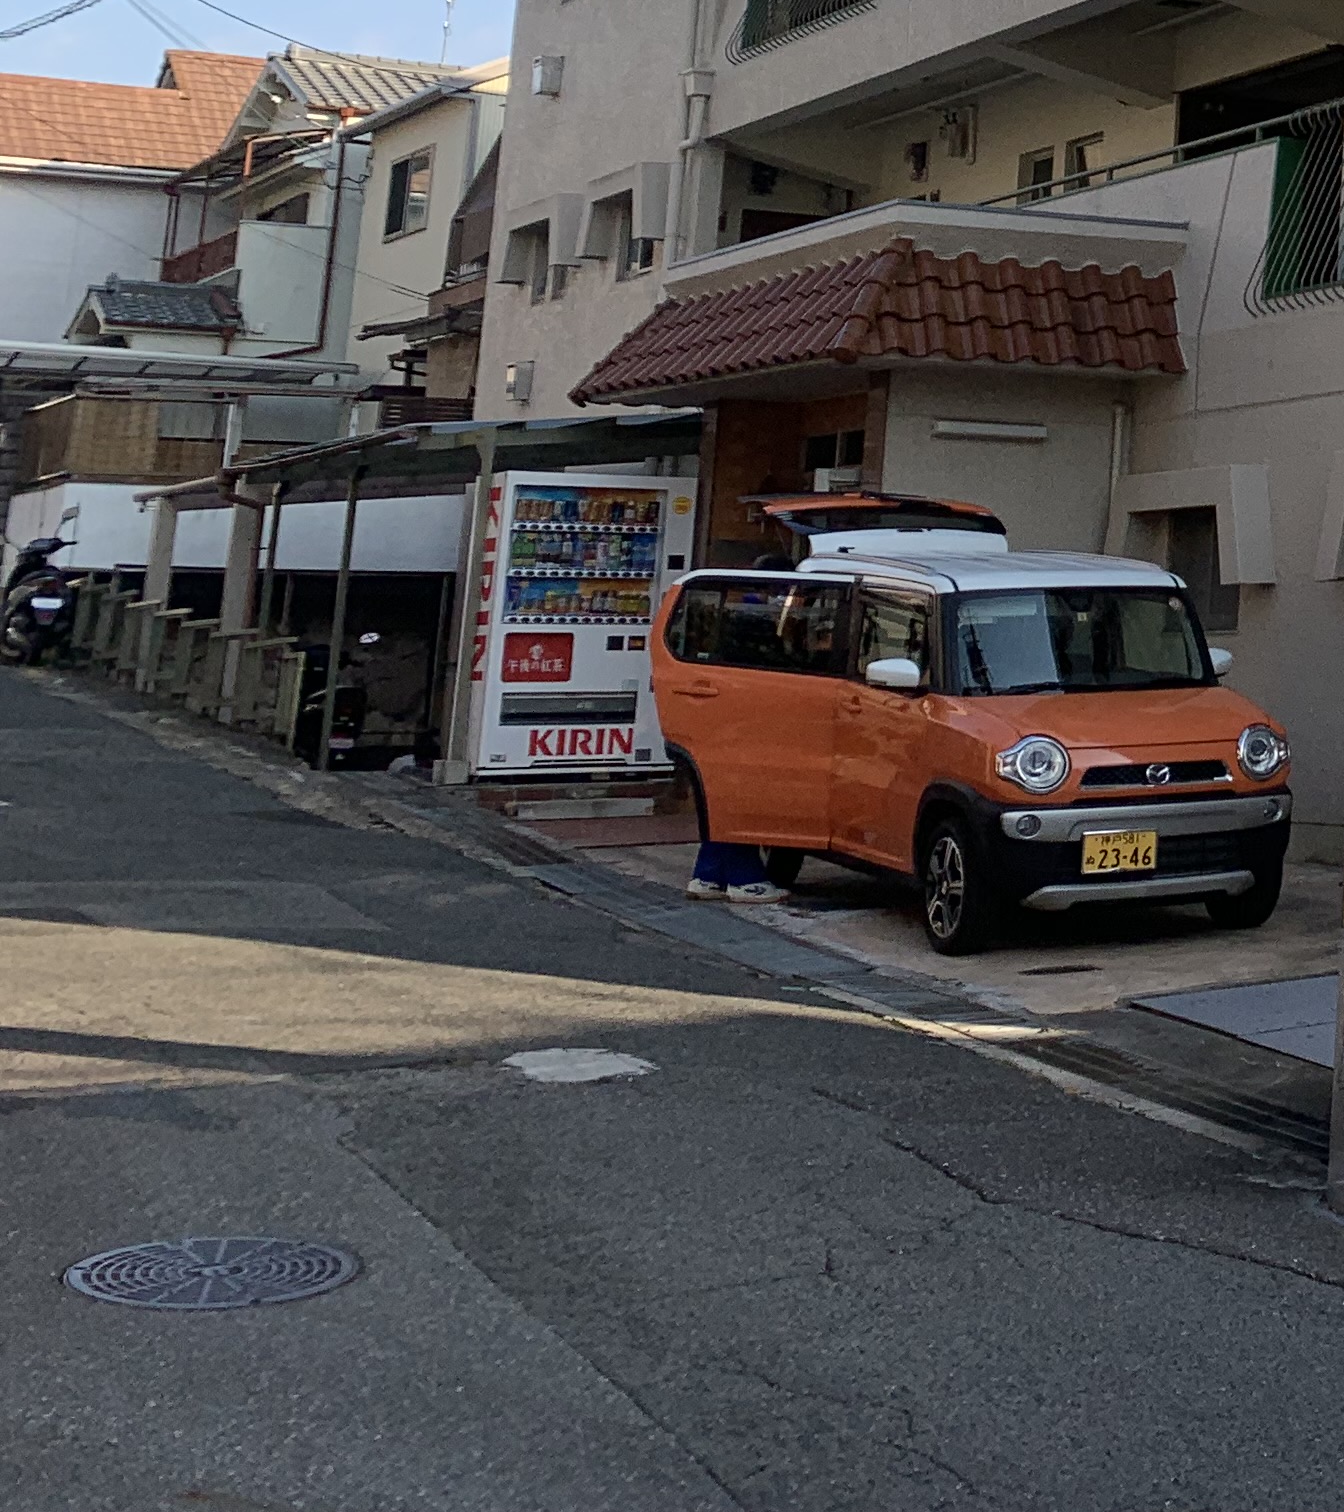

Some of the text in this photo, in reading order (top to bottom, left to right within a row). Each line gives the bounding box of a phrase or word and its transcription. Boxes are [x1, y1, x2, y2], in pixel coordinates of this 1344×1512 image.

[508, 658, 566, 673] 午後の紅茶
[528, 727, 635, 757] KIRIN
[1097, 846, 1152, 869] 23-46
